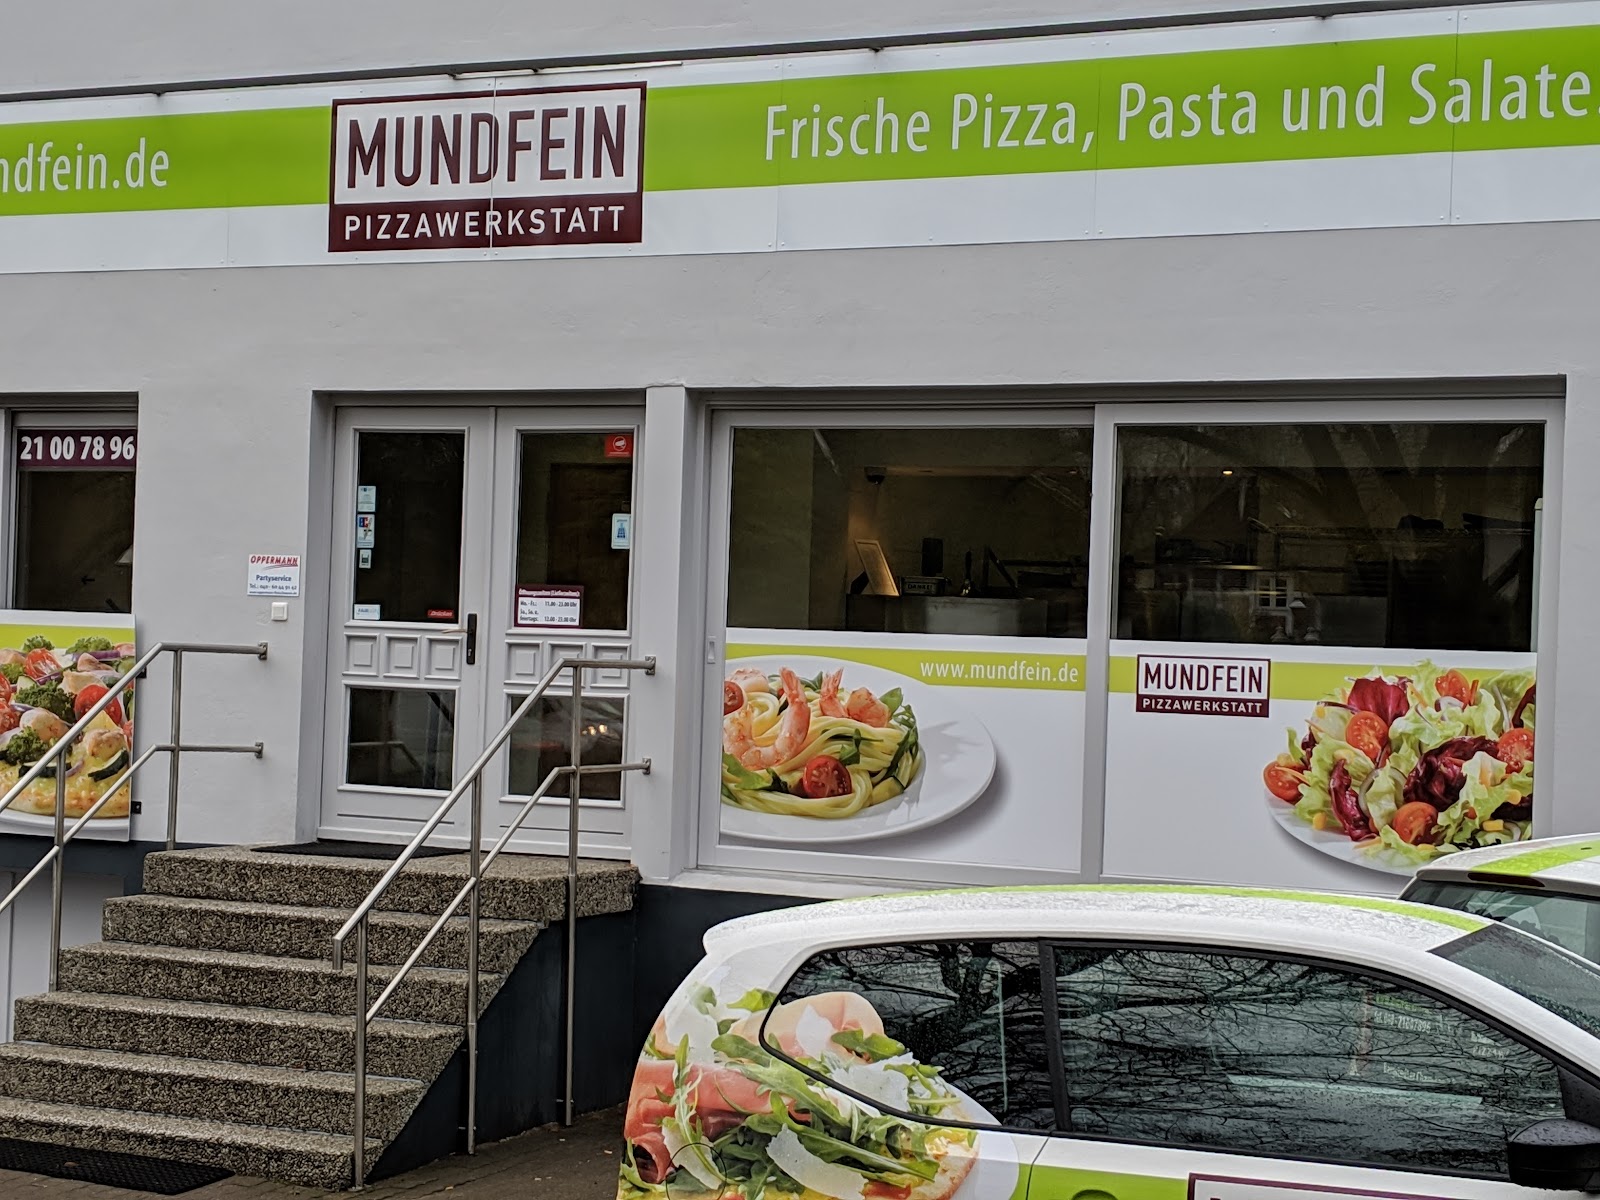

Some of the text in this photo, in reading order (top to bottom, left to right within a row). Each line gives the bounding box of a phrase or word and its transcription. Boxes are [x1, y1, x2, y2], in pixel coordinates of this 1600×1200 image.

[766, 58, 1600, 161] Frische Pizza, Pasta und Salate
[347, 104, 627, 188] MUNDFEIN
[344, 205, 625, 241] PIZZAWERKSTATT
[20, 435, 135, 460] 21 00 78 96
[250, 555, 299, 565] OPPERMANN
[256, 574, 292, 582] Partyservice
[919, 660, 1079, 683] www.mundfein.de
[1143, 661, 1264, 693] MUNDFEIN
[1142, 697, 1263, 714] PIZZAWERKSTATT
